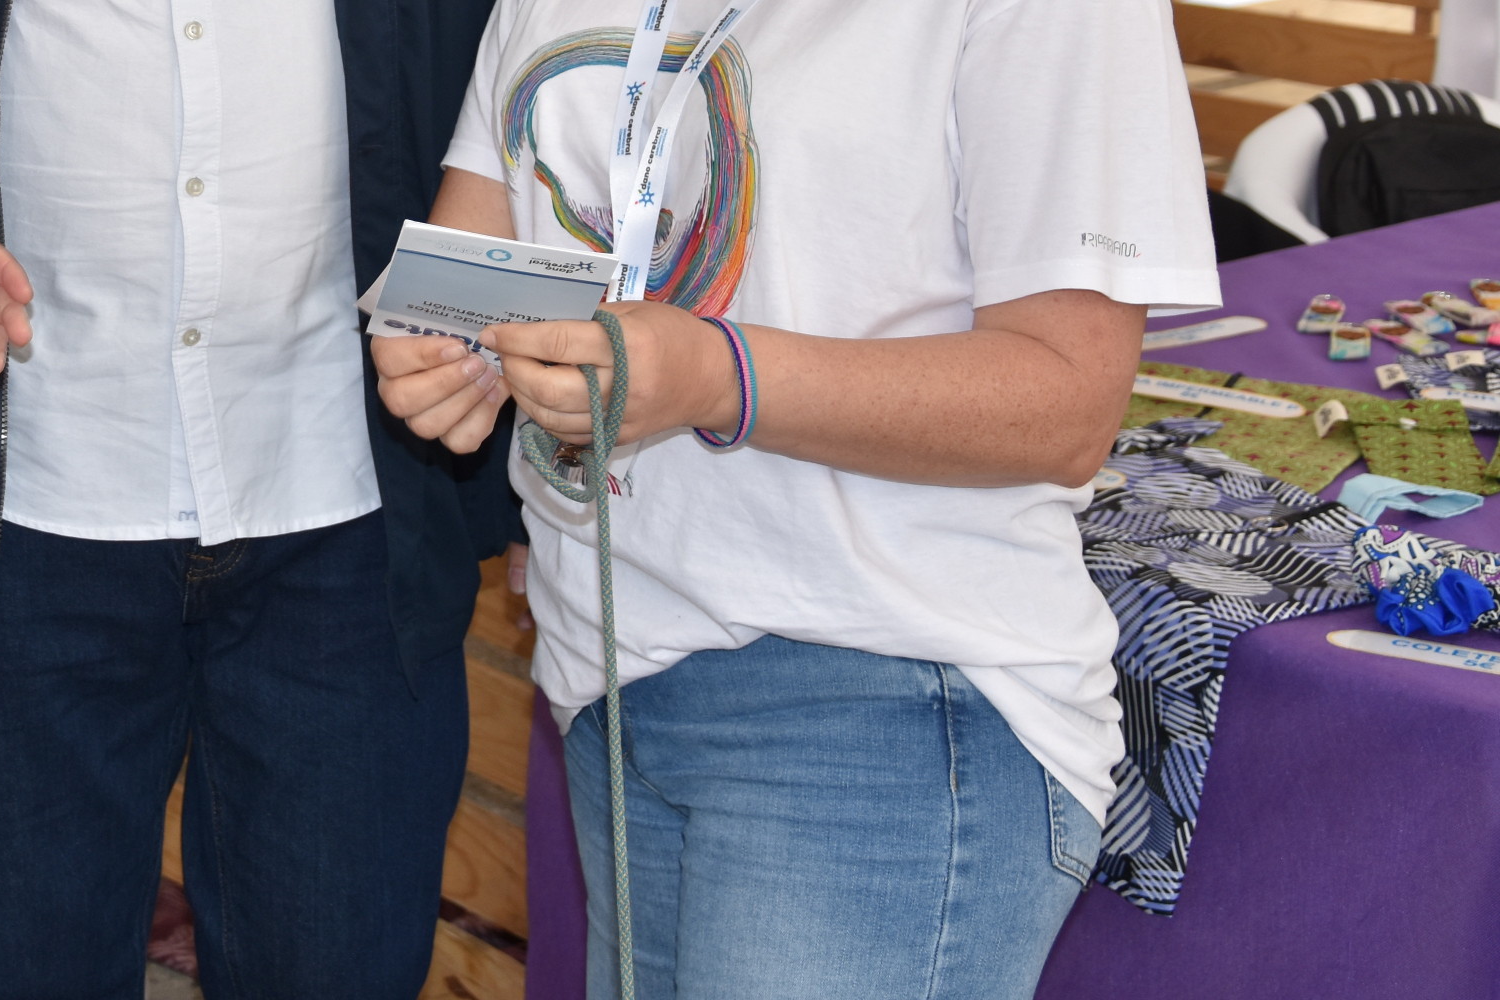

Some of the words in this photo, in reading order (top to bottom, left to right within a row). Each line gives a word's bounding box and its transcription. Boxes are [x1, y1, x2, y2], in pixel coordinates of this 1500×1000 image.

[630, 95, 640, 117] dano
[625, 118, 634, 156] cerebral
[640, 166, 651, 190] dano
[647, 126, 662, 165] cerebral
[528, 258, 575, 270] cerebral
[545, 266, 574, 274] dano
[616, 263, 629, 301] cerebral
[406, 303, 449, 317] mitos
[423, 299, 511, 323] prevención
[453, 314, 491, 326] ando
[1463, 659, 1496, 670] 5€
